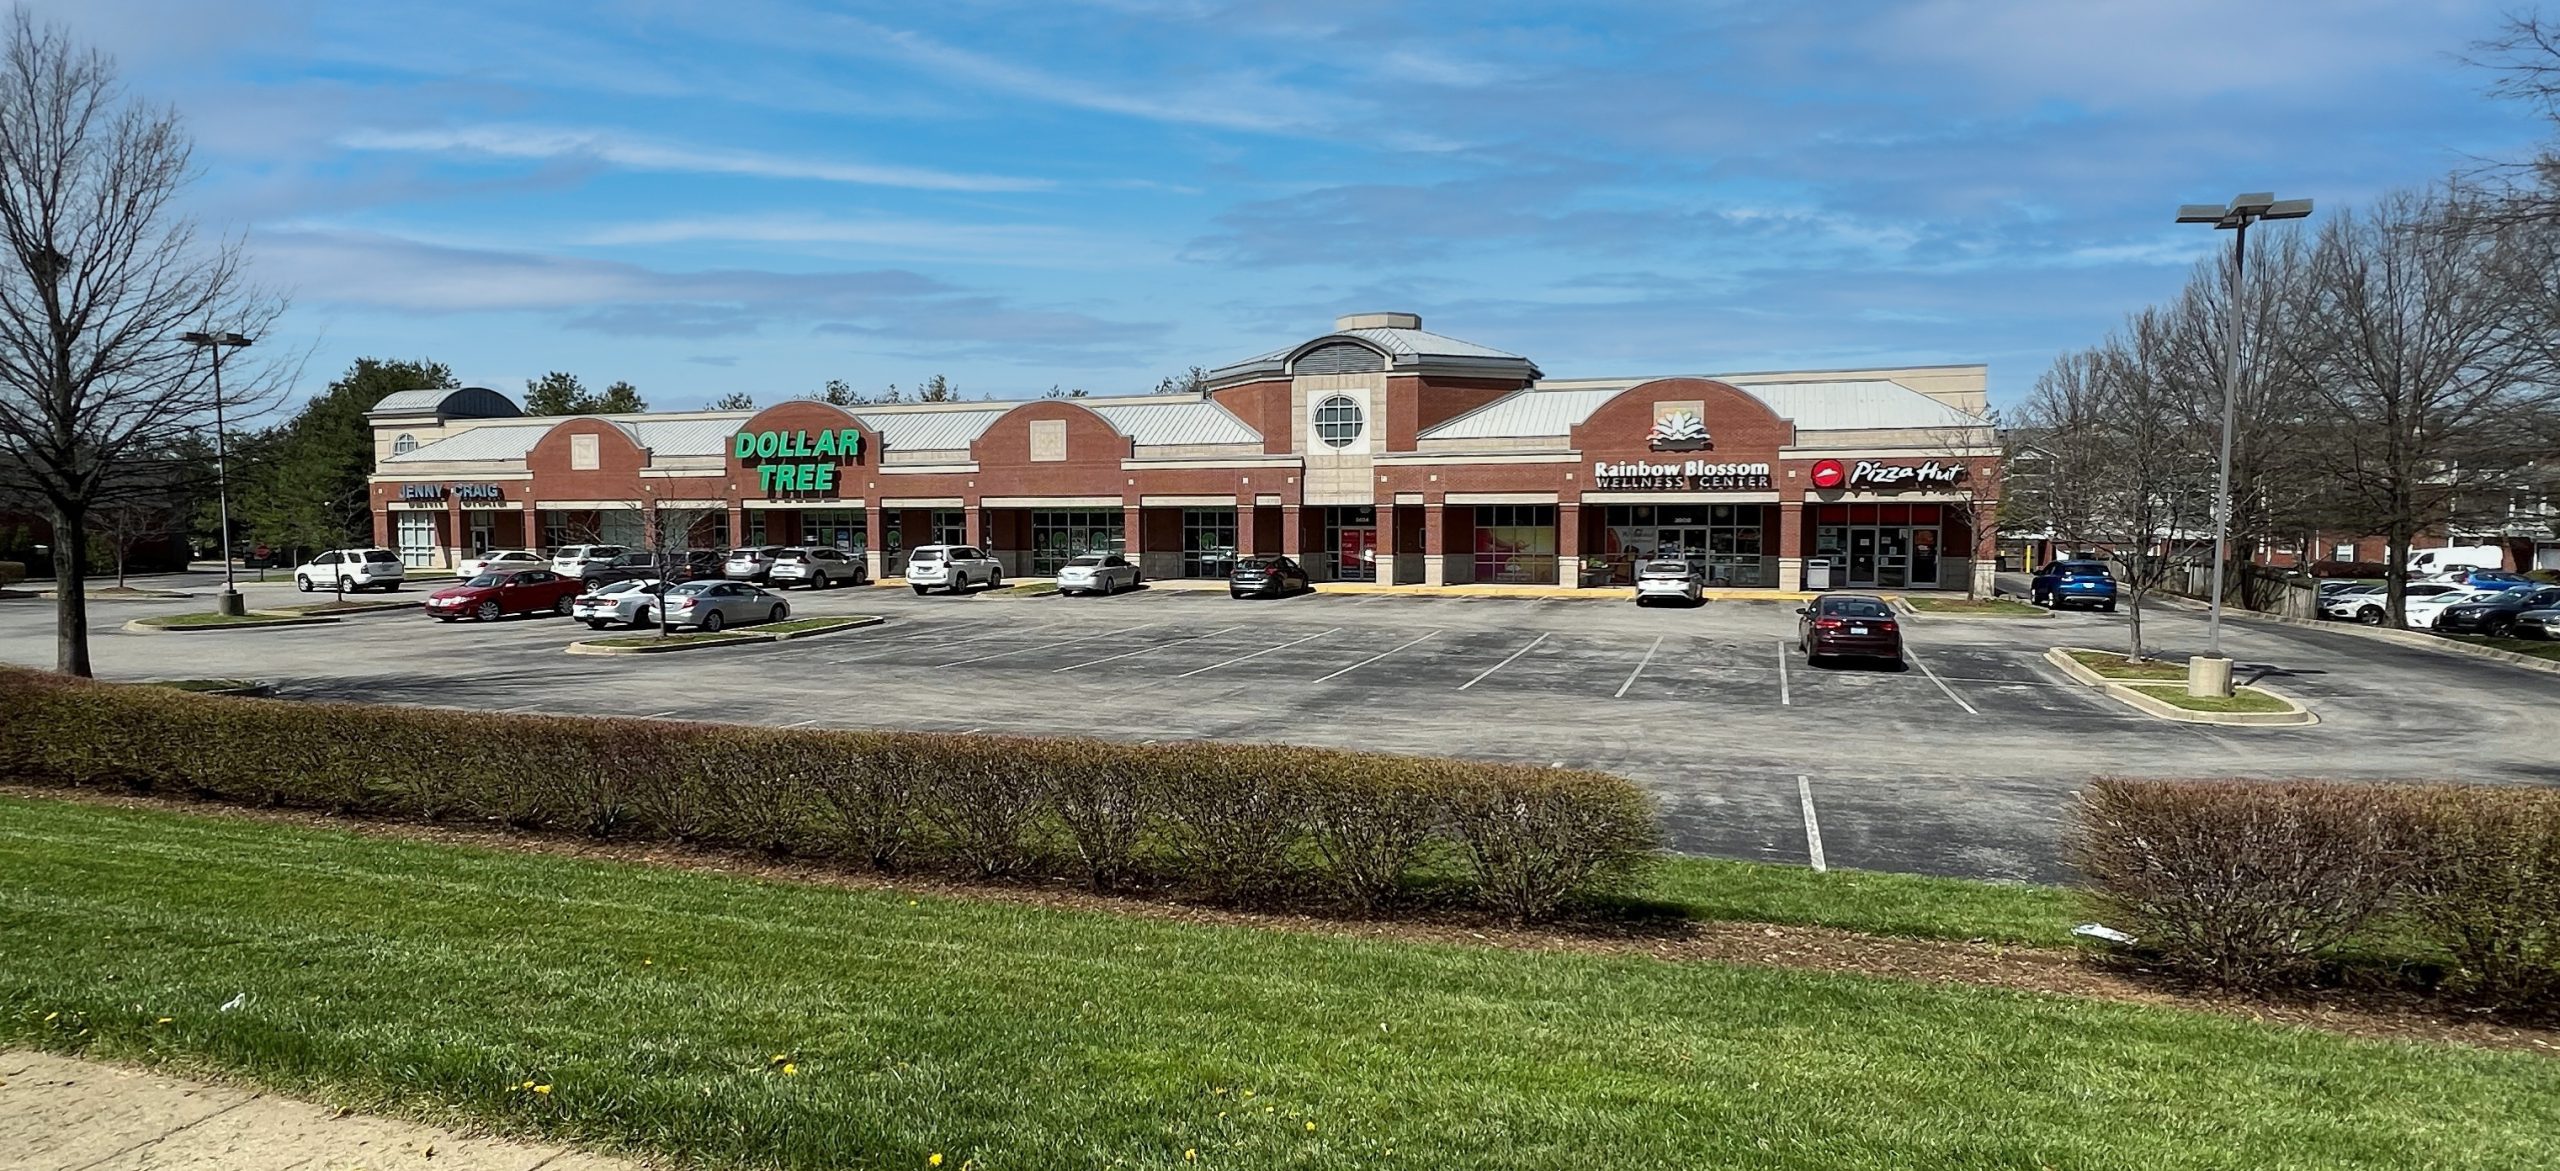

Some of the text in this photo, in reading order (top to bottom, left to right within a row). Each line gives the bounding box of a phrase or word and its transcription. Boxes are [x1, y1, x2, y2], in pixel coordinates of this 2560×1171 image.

[735, 429, 860, 458] DOLLAR
[757, 463, 835, 491] TREE
[1594, 460, 1769, 477] Rainbow Blossom
[1850, 460, 1965, 483] Pizza Hut
[399, 483, 498, 499] JENNY CRAIG
[1596, 476, 1768, 488] WELLNESS CENTER
